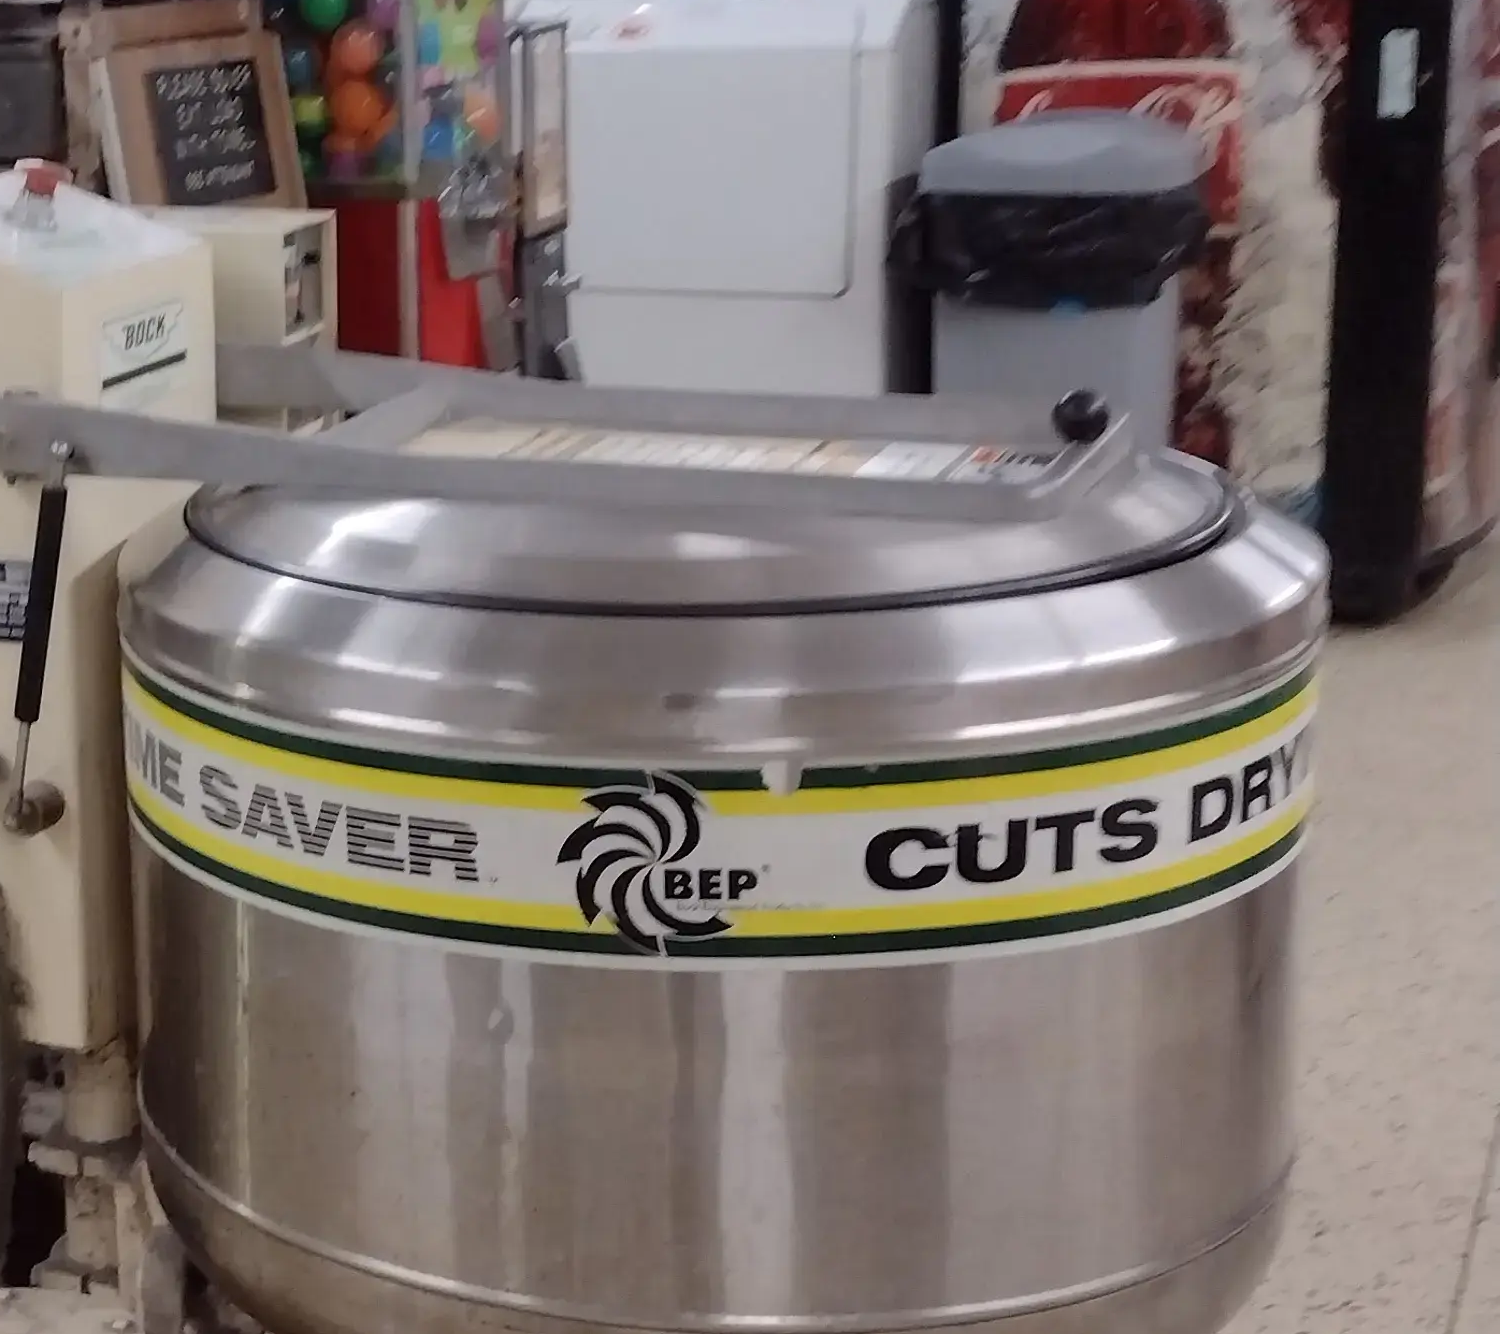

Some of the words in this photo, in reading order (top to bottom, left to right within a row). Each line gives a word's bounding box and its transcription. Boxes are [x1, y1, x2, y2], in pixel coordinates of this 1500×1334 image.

[121, 312, 167, 351] BOCK
[198, 765, 479, 882] SAVER
[864, 798, 1160, 891] CUTS
[664, 870, 758, 900] BEP
